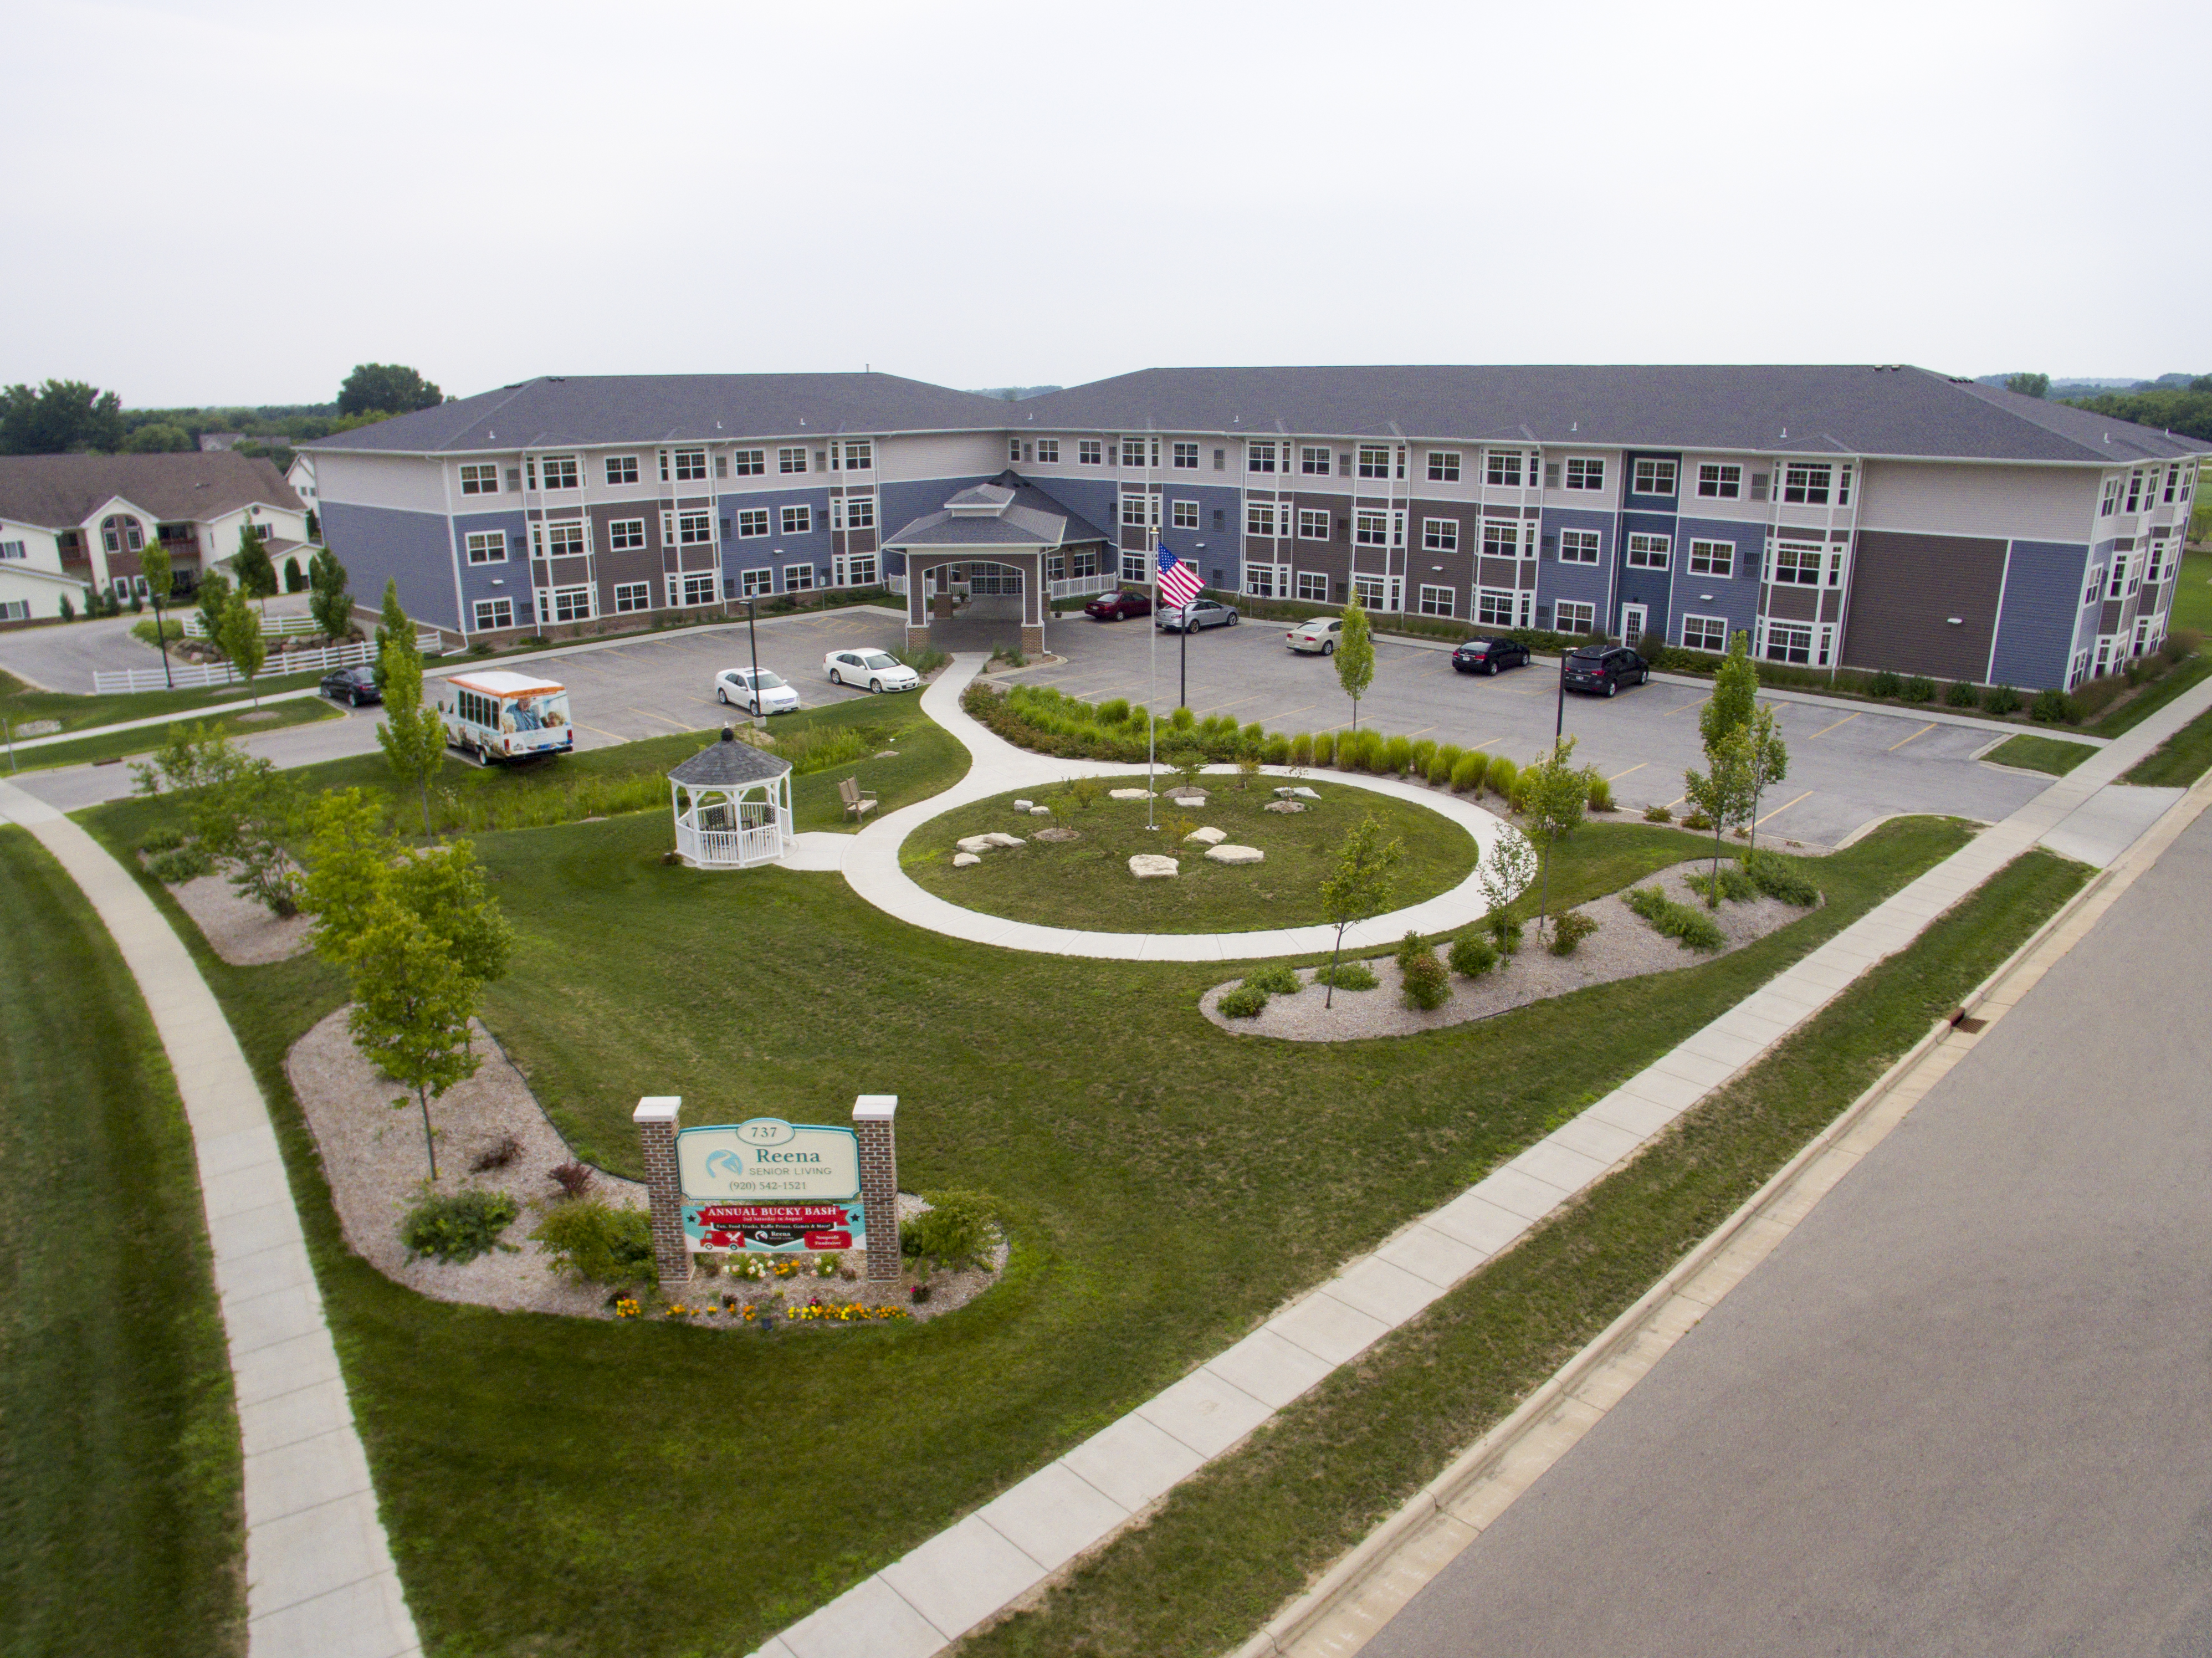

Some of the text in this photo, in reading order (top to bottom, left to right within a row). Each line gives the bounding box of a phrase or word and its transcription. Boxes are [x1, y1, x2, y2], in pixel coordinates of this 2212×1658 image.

[751, 1127, 777, 1137] 737
[755, 1148, 821, 1163] Reena
[729, 1181, 807, 1191] (920) 542-1521
[805, 1207, 837, 1215] BASH
